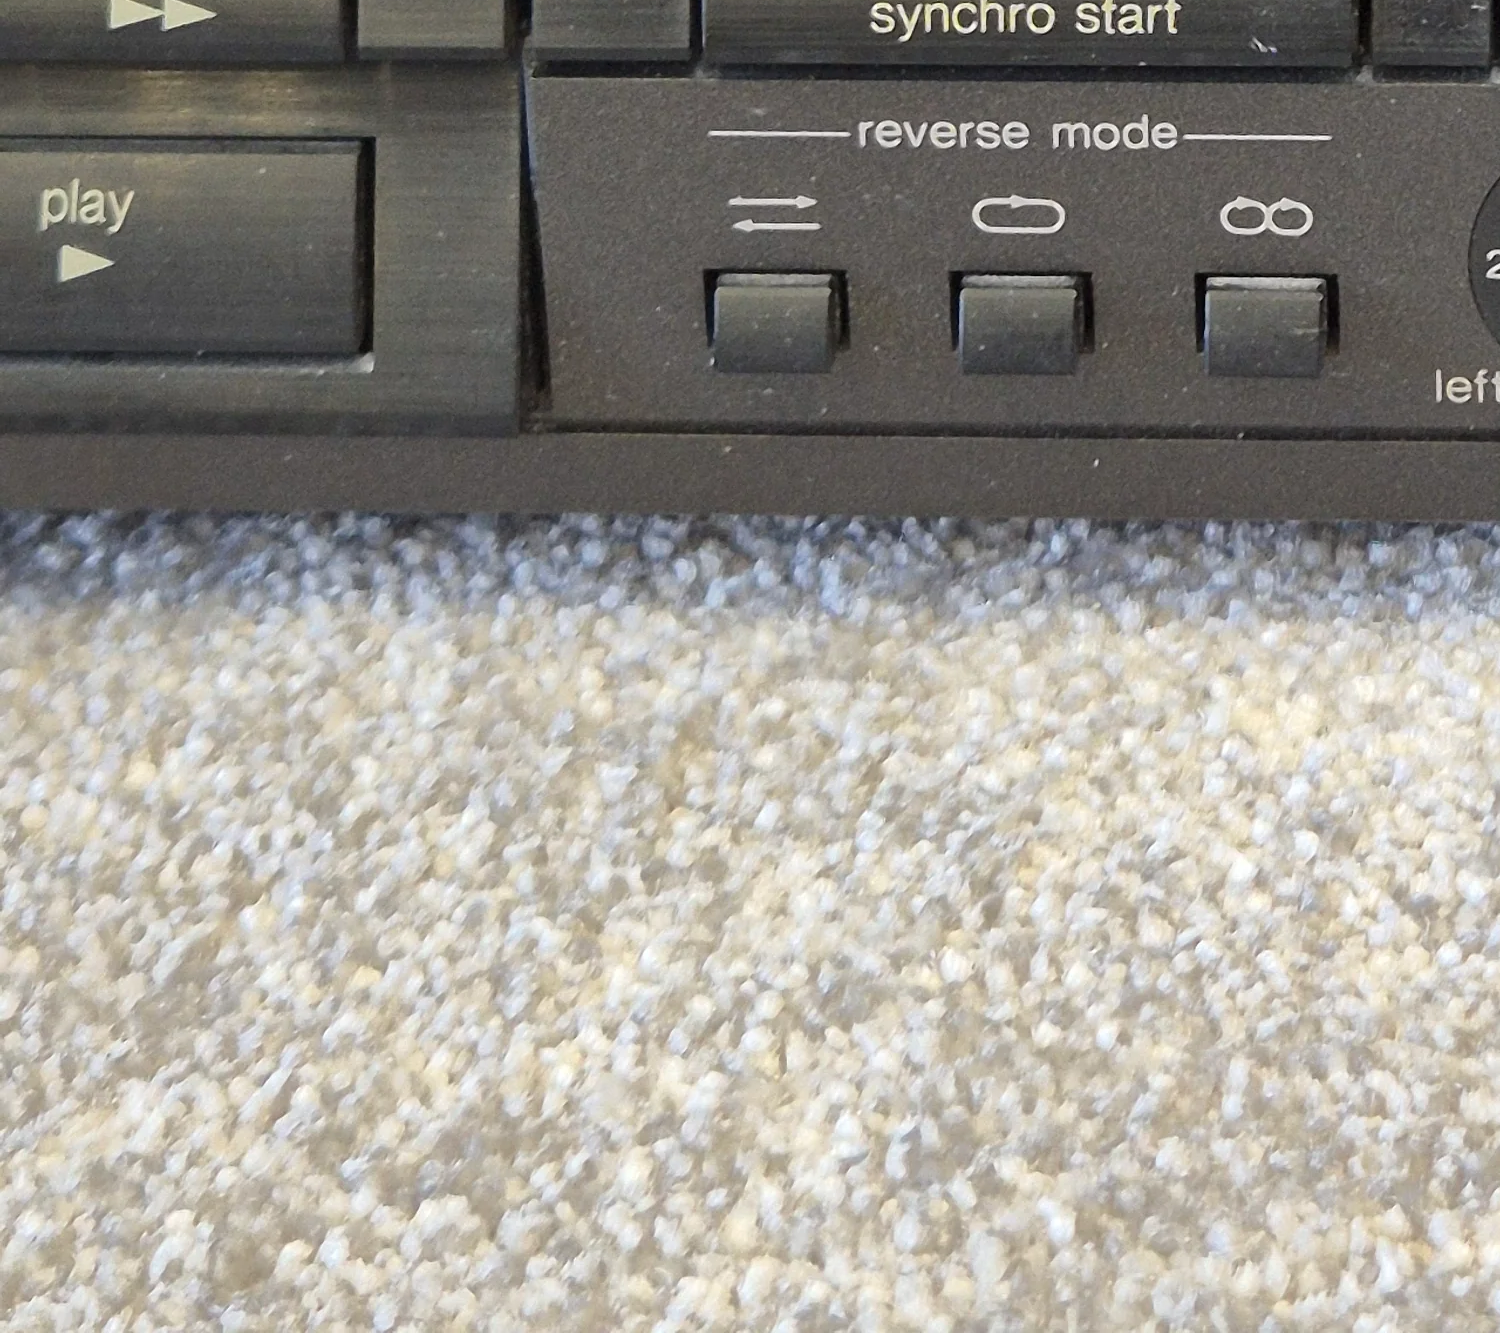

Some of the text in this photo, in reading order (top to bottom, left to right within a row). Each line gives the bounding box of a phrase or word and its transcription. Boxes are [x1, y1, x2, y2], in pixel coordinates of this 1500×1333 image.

[858, 114, 1178, 149] reverse mode
[38, 177, 135, 234] play
